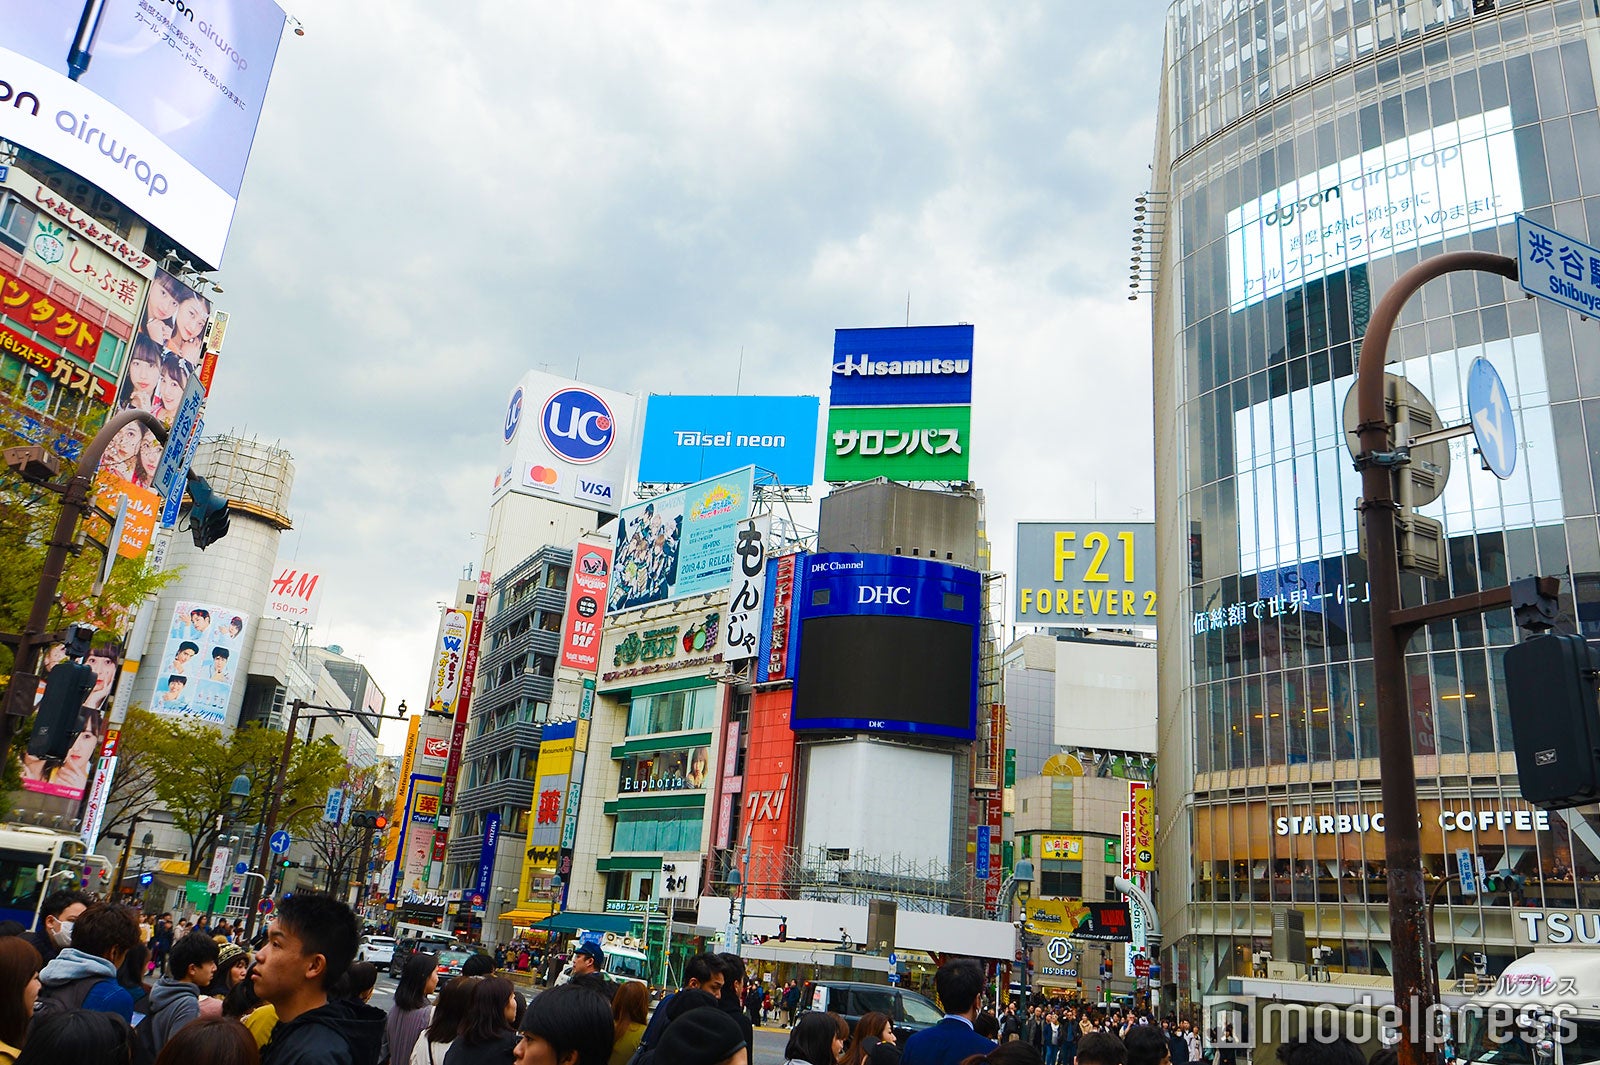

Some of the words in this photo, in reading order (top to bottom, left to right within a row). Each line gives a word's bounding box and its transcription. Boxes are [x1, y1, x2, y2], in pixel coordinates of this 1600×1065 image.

[198, 20, 248, 71] airwrap
[56, 110, 168, 197] airwrap
[1265, 183, 1342, 228] dyson
[1350, 145, 1461, 193] airwrap
[36, 186, 151, 269] しゃぶしゃぶバイキング
[69, 246, 138, 306] しゃぶ葉
[51, 357, 105, 398] ガスト
[832, 354, 970, 377] Hisamitsu
[549, 401, 608, 446] UC
[673, 431, 731, 448] Taisei
[736, 434, 786, 448] neon
[832, 428, 963, 456] サロンパス
[579, 480, 612, 499] VISA
[121, 534, 143, 549] SALE
[811, 562, 829, 573] DHC
[829, 560, 864, 571] Channel
[1053, 531, 1135, 583] F21
[271, 569, 319, 601] H&M
[727, 519, 764, 654] もんじゃ
[857, 585, 911, 605] DHC
[272, 602, 298, 613] 150m
[1020, 588, 1136, 616] FOREVER
[868, 720, 886, 729] DHC
[398, 757, 411, 797] Matsumoto
[624, 775, 683, 793] Euphoria
[537, 789, 562, 825] 薬
[746, 773, 790, 820] クスリ
[488, 820, 497, 847] MIZUHO
[1276, 813, 1422, 836] STARBUC
[1438, 810, 1550, 831] COFFEE
[1139, 851, 1150, 861] 4F
[1042, 966, 1077, 977] ITS'DEMO
